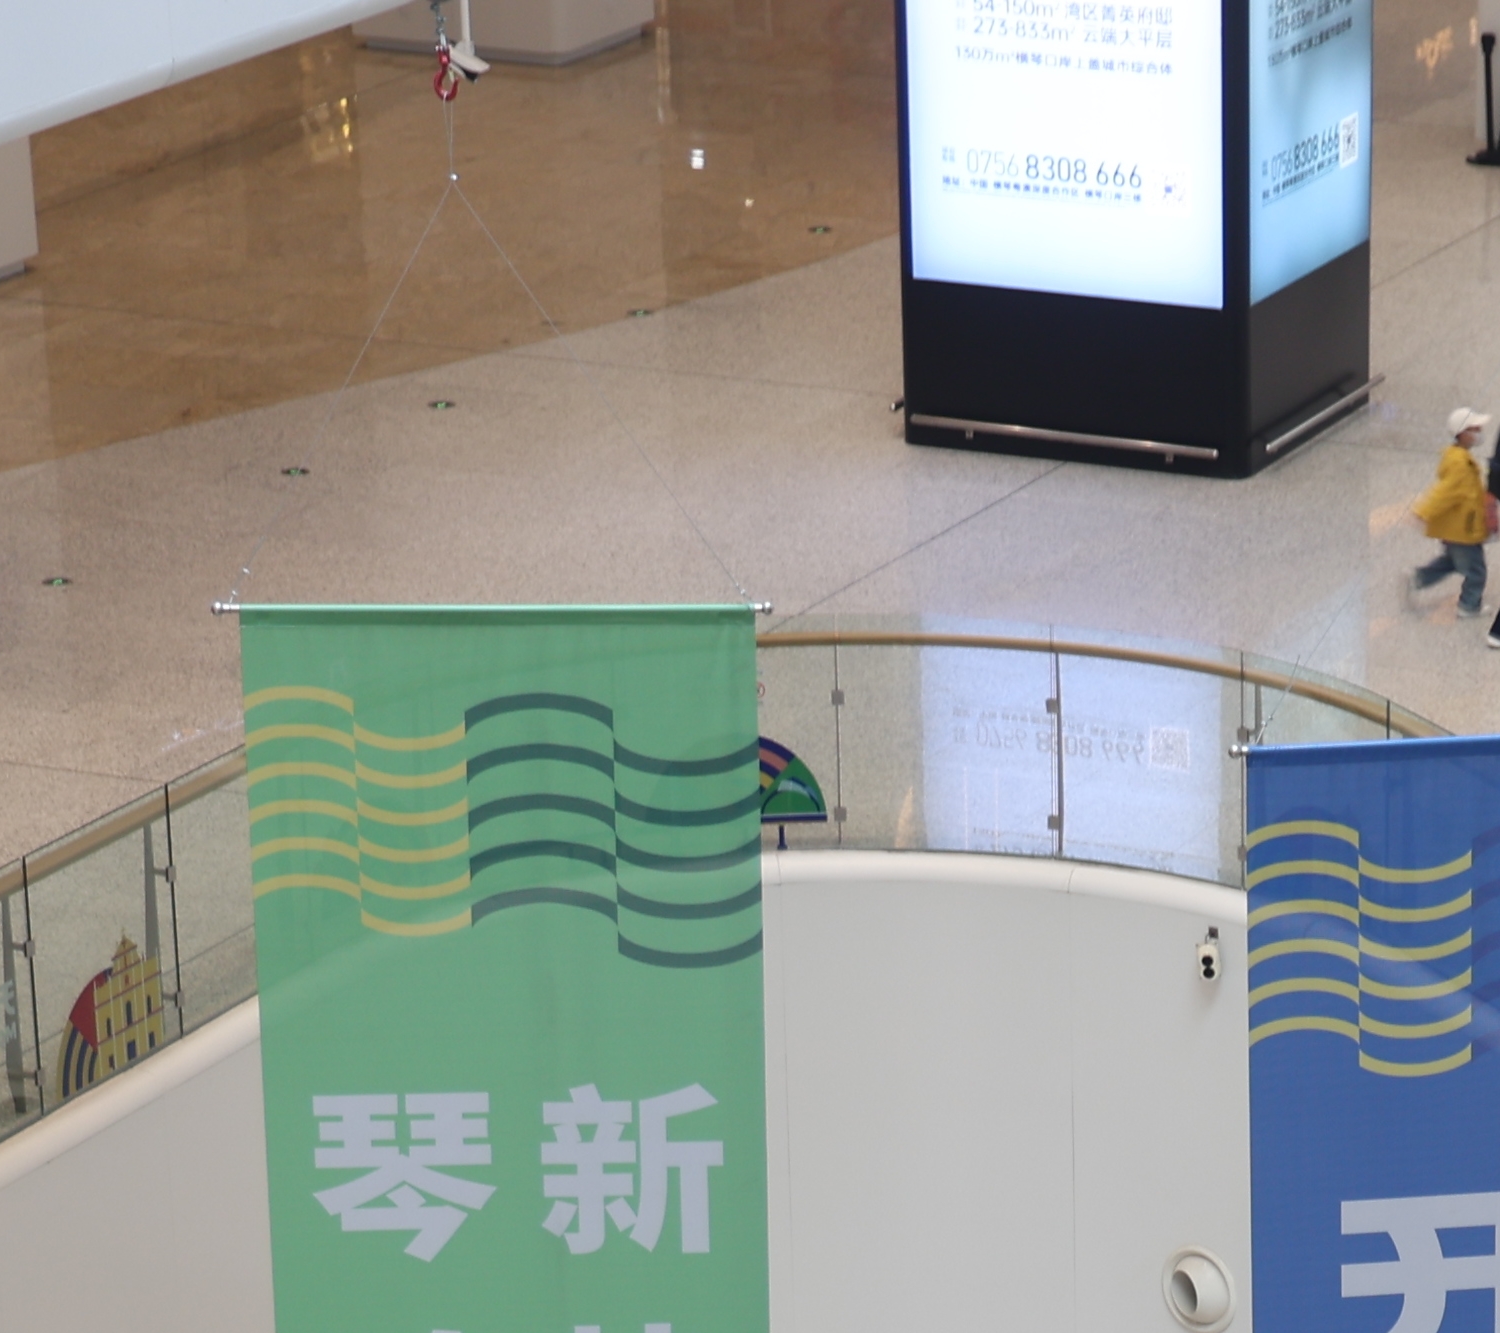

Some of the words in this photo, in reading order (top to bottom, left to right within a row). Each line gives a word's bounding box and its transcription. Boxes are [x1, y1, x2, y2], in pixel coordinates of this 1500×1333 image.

[966, 148, 1019, 178] 0756
[1025, 154, 1088, 183] 8308
[1095, 160, 1143, 189] 666
